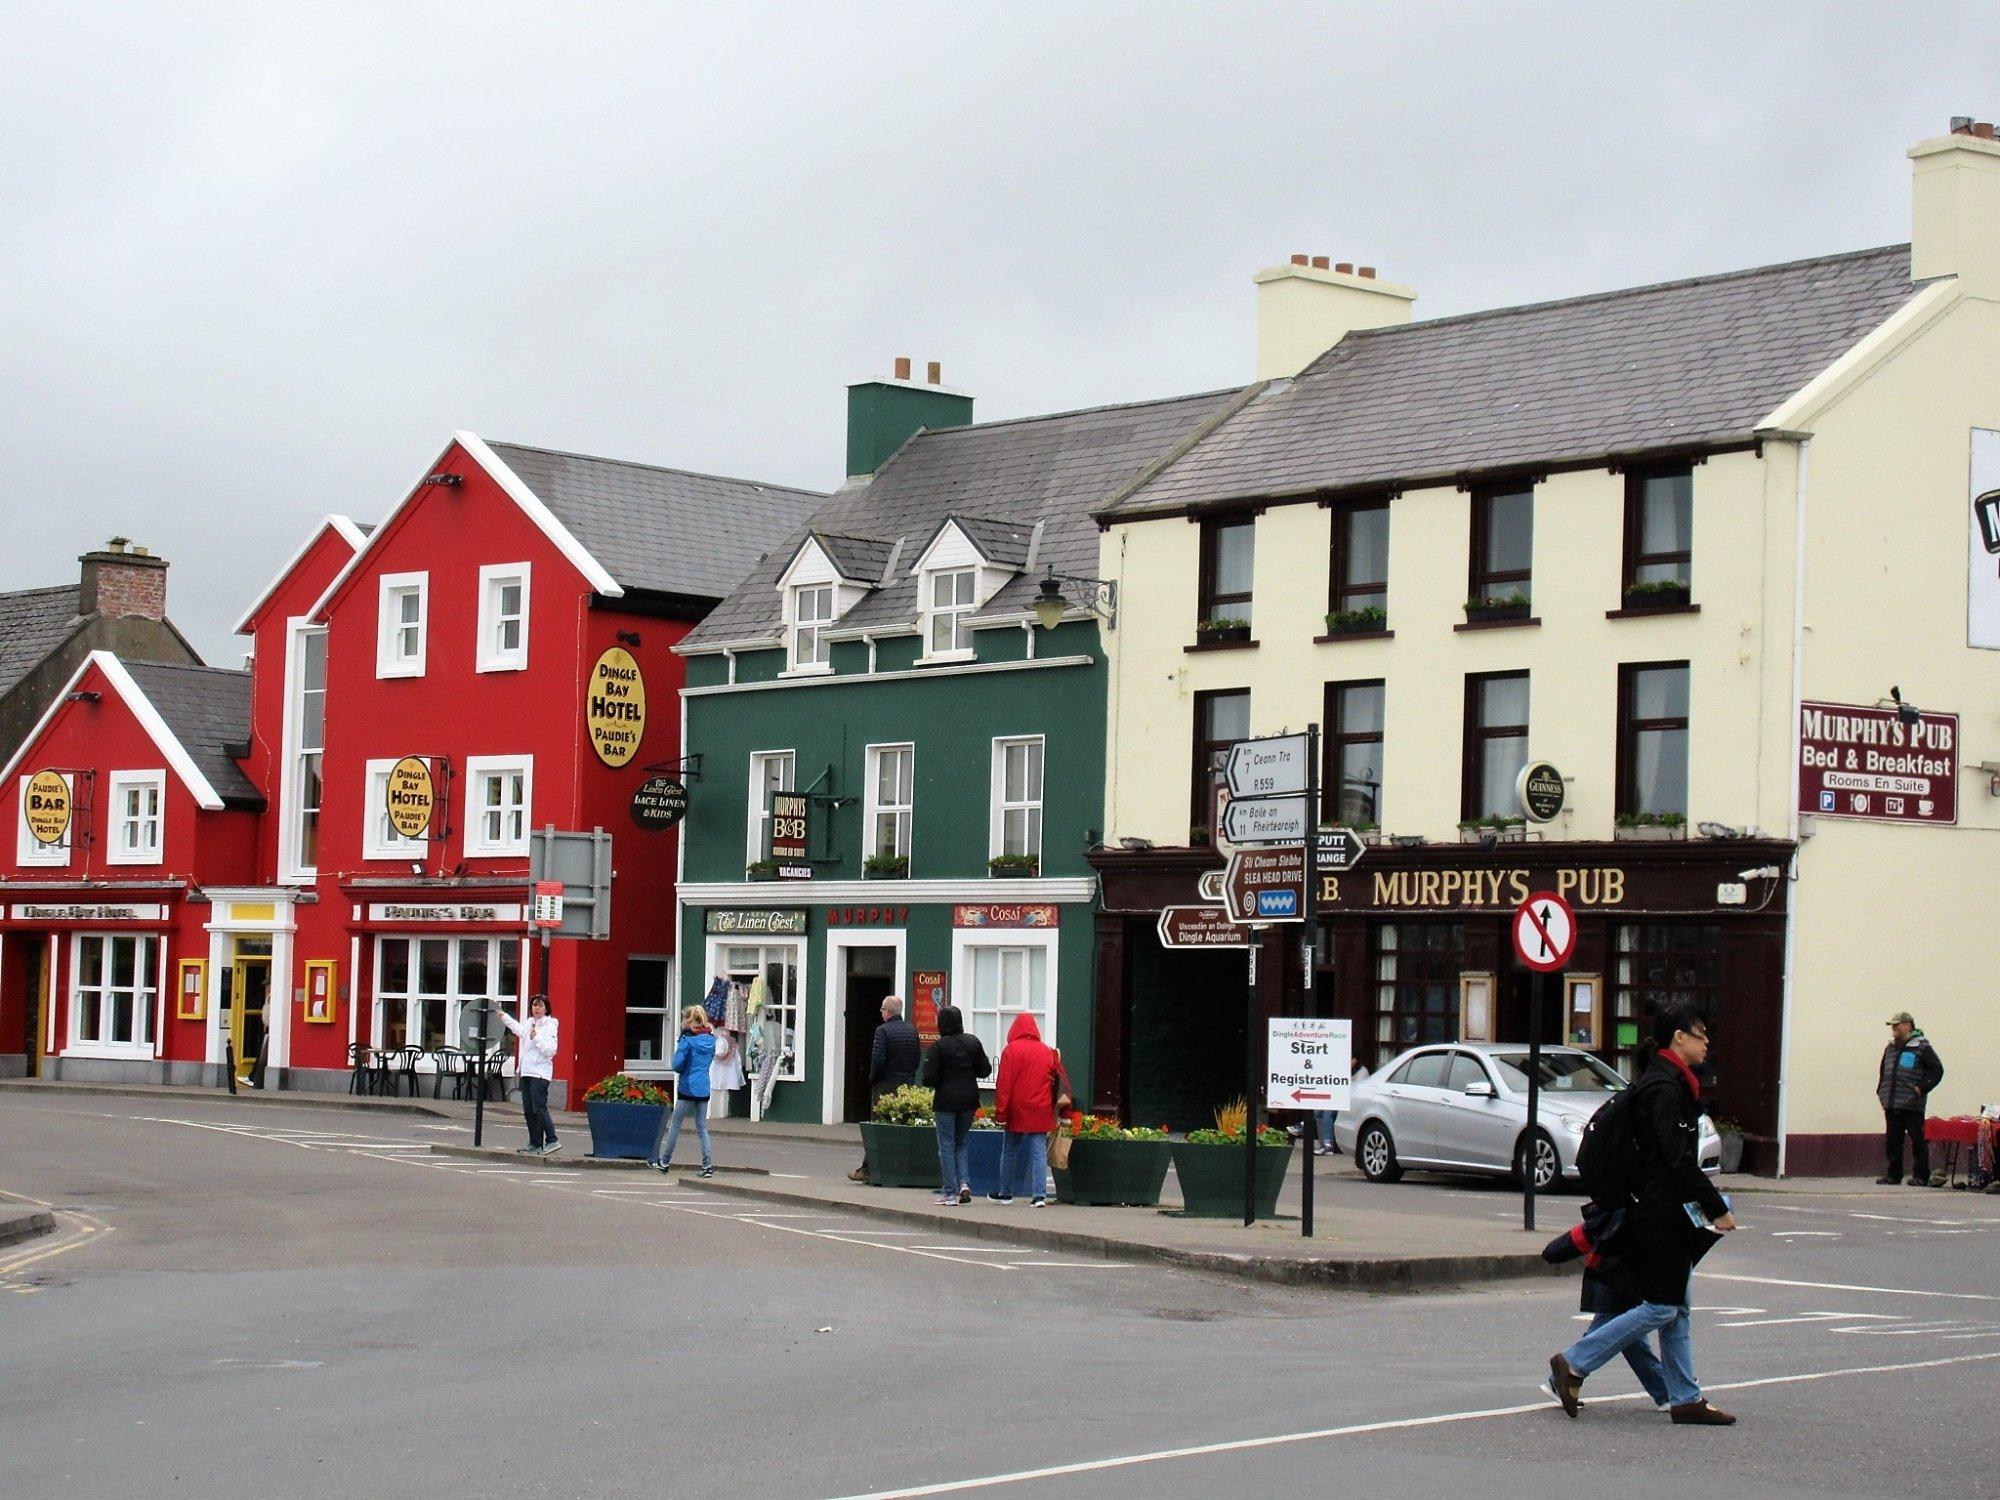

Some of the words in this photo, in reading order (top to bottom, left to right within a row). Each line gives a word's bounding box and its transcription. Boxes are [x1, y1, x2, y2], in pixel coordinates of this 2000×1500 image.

[600, 664, 637, 680] DINGLE
[606, 681, 629, 697] BAY
[592, 696, 641, 721] HOTEL
[595, 727, 636, 743] PAUDIE'S
[1802, 709, 1904, 747] MURPHY'S
[1910, 719, 1952, 750] PUB
[604, 743, 626, 756] BAR
[1803, 745, 1838, 768] Bed
[1845, 749, 1859, 769] &
[1866, 750, 1951, 776] Breakfast
[397, 769, 426, 780] DINGLE
[1245, 763, 1250, 774] 7
[33, 783, 63, 793] PAUDIE'S
[402, 780, 419, 790] BAY
[1530, 780, 1562, 794] GUINNESS
[1829, 774, 1869, 788] Rooms
[1874, 777, 1890, 788] En
[1895, 779, 1924, 792] Suite
[31, 795, 66, 810] BAR
[391, 790, 430, 806] HOTEL
[634, 795, 657, 805] LACE
[659, 797, 687, 808] LINEN
[394, 811, 426, 821] PAUDIE'S
[36, 825, 61, 834] HOTEL
[401, 821, 419, 829] BAR
[774, 818, 806, 839] B&B
[1240, 824, 1246, 835] 11
[1319, 836, 1346, 846] PUTT
[1244, 872, 1261, 884] SLEA
[1262, 871, 1281, 883] HEAD
[1282, 870, 1303, 882] DRIVE
[1372, 869, 1530, 905] MURPHY'S
[1556, 868, 1625, 905] PUB
[460, 906, 495, 919] BAR
[827, 907, 909, 926] MURPHY
[716, 911, 736, 932] The
[737, 911, 767, 929] Linen
[768, 911, 795, 932] Chest
[1178, 931, 1203, 944] Dingle
[1205, 931, 1241, 943] Aquarium
[1290, 1041, 1328, 1055] Start
[1304, 1059, 1313, 1069] &
[1271, 1073, 1349, 1087] Registration
